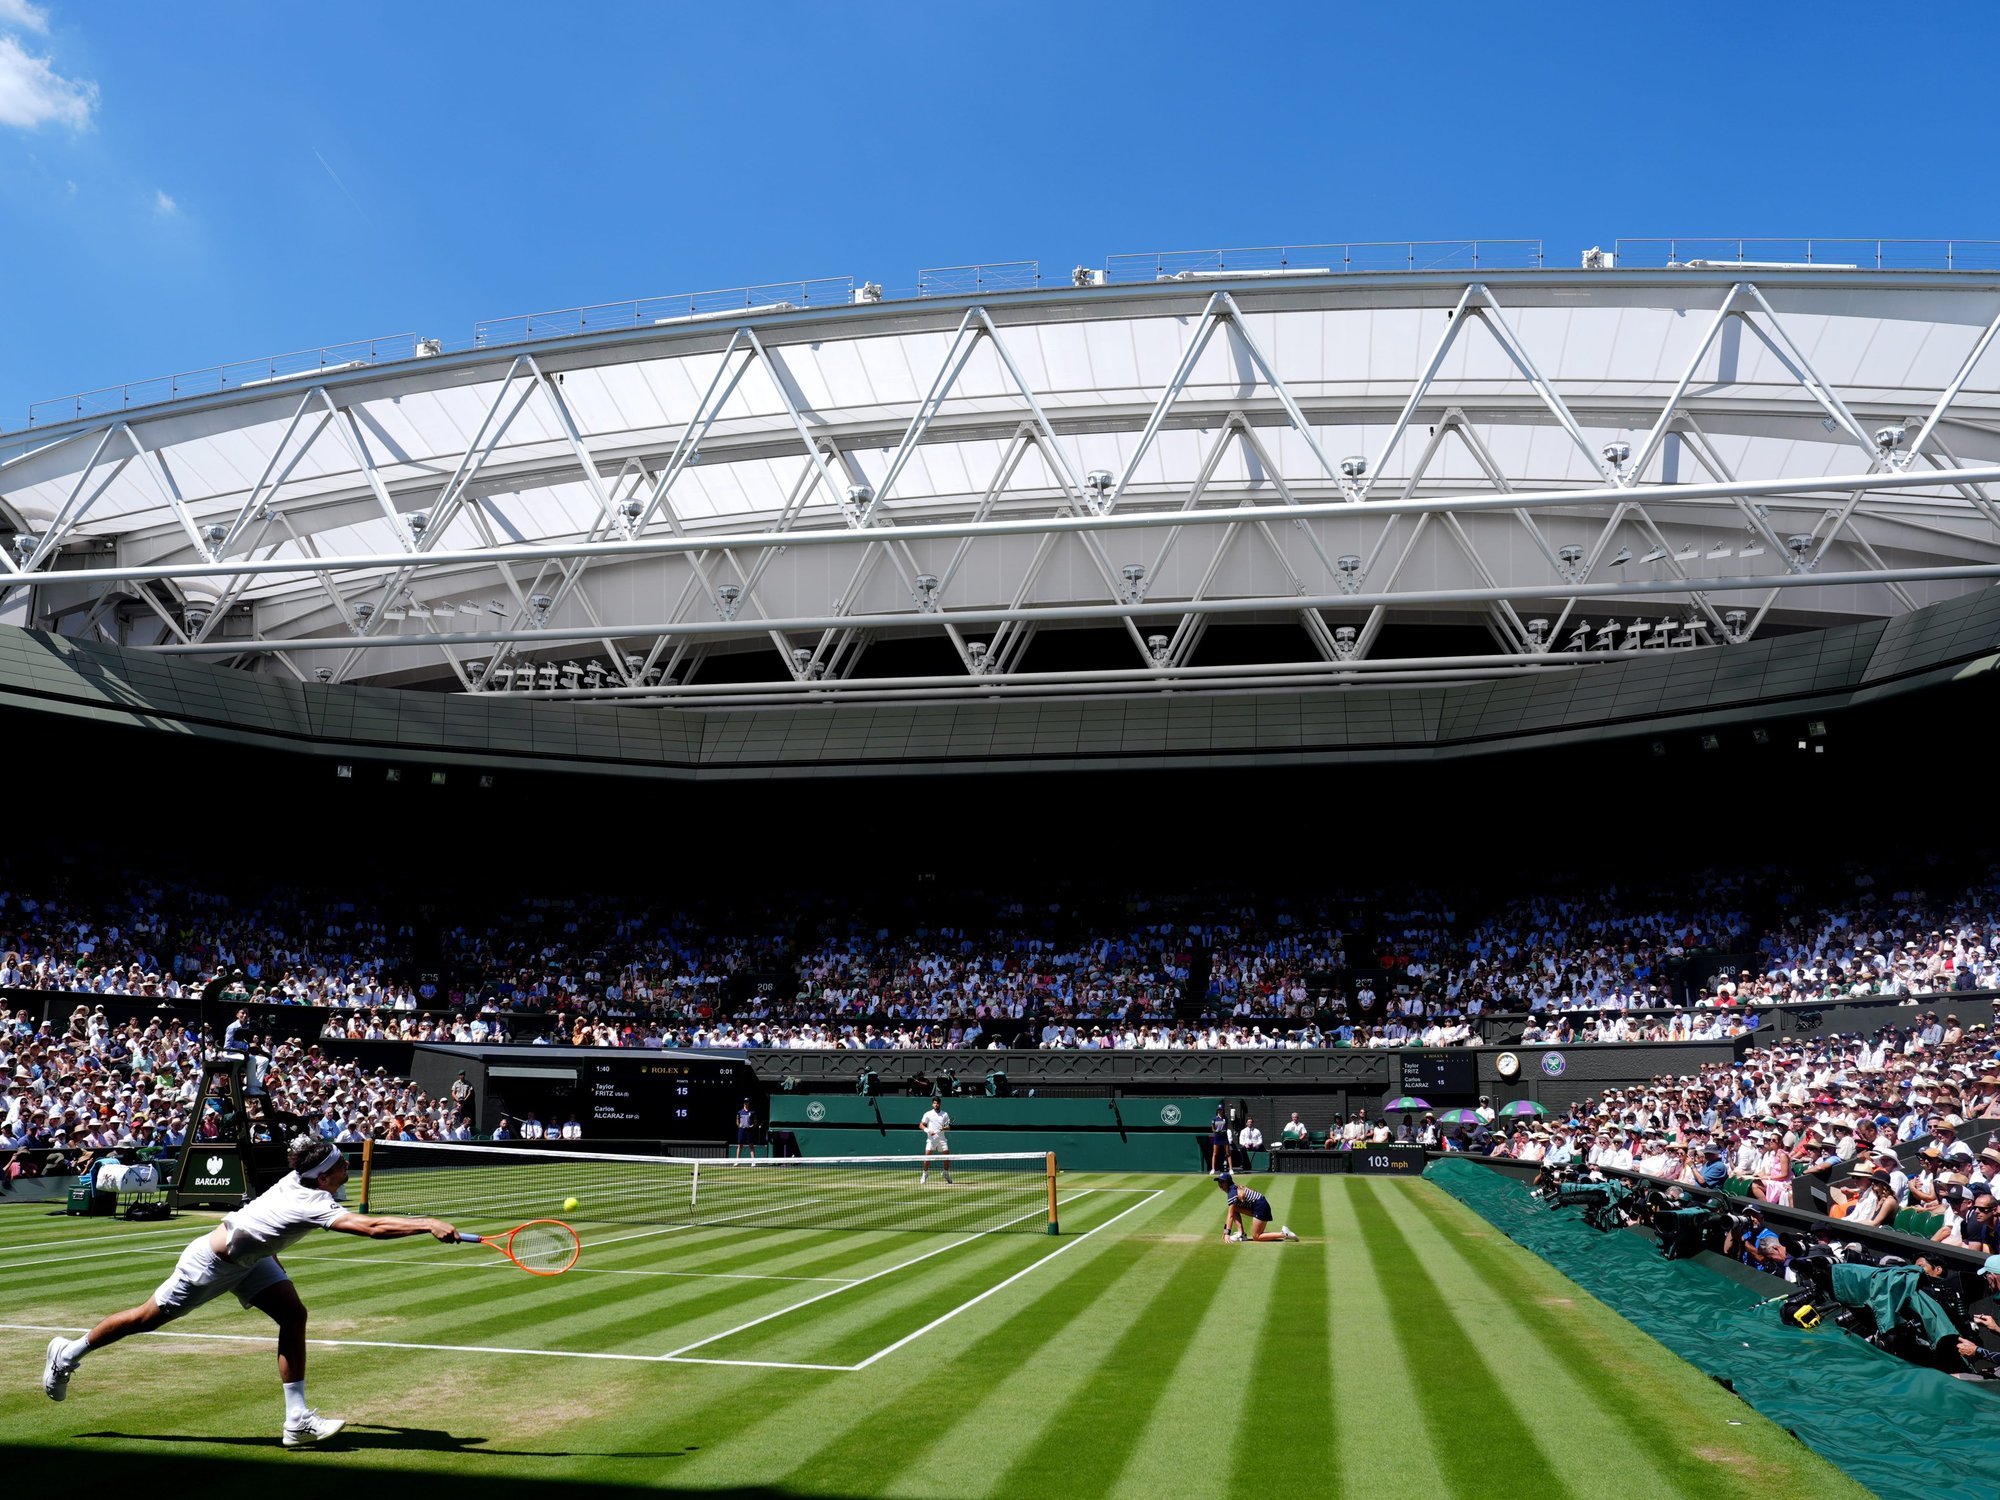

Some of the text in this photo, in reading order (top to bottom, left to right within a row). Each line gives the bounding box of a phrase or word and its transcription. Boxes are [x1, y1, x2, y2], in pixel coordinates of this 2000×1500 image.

[757, 983, 774, 991] 206
[676, 1087, 688, 1095] 15
[675, 1109, 687, 1117] 15
[1352, 1141, 1367, 1149] IBM
[1367, 1155, 1409, 1169] 103 mph
[194, 1177, 231, 1186] BARCLAYS
